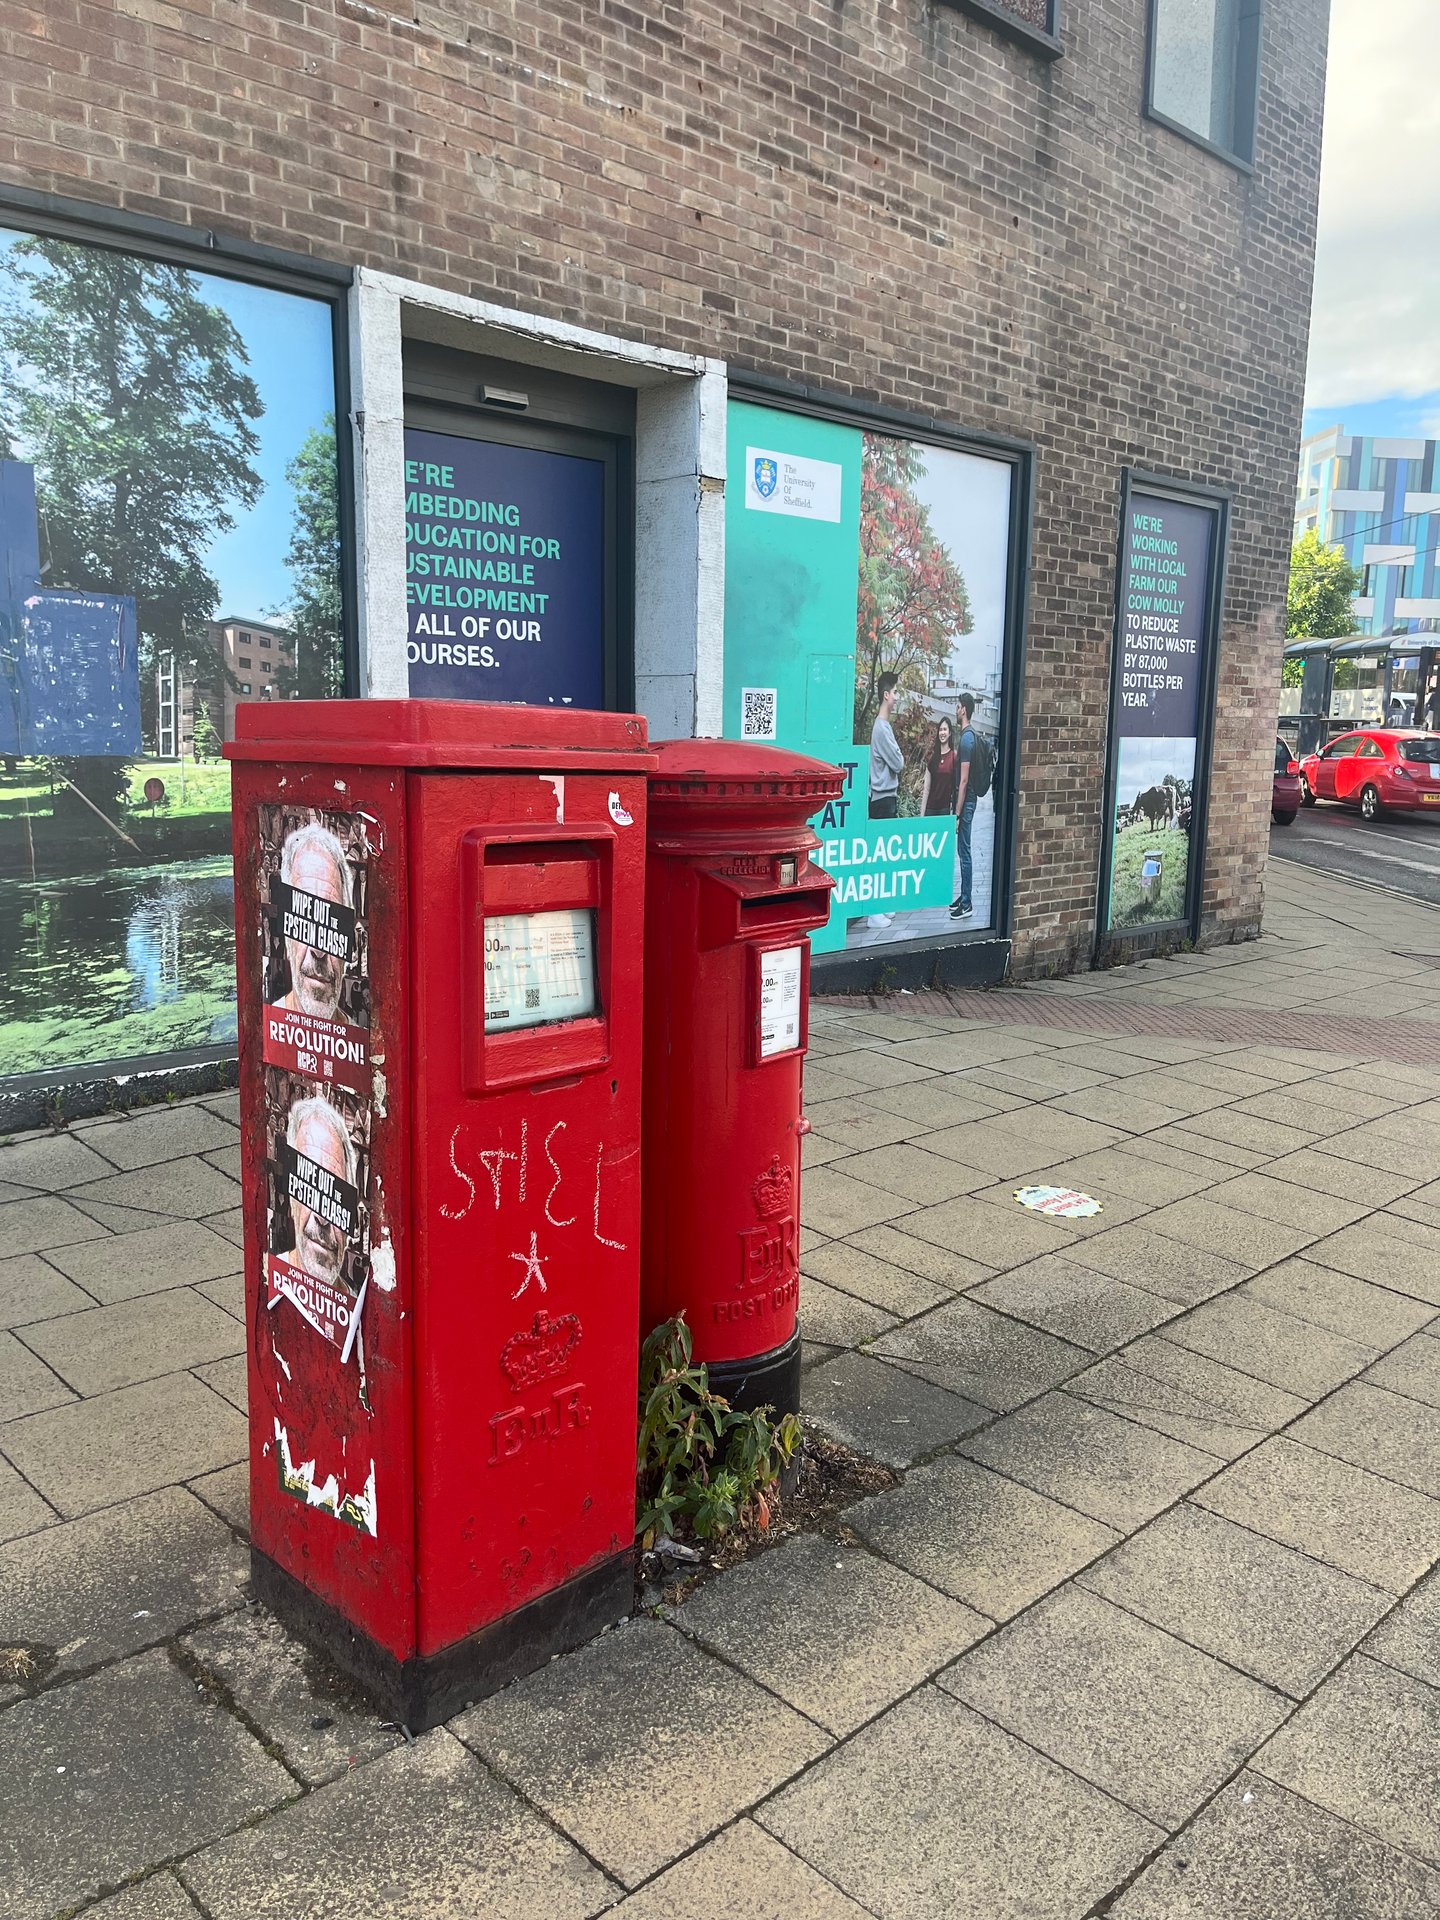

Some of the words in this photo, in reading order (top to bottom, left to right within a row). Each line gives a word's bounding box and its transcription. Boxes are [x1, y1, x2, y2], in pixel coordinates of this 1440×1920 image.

[405, 460, 455, 488] E'RE
[784, 464, 797, 474] The
[784, 475, 816, 490] University
[405, 491, 520, 526] MBEDDING
[1133, 513, 1163, 534] WE'RE
[405, 522, 515, 555] DUCATION
[519, 535, 561, 560] FOR
[1131, 534, 1178, 555] WORKING
[1130, 554, 1156, 572] WITH
[1158, 559, 1187, 577] LOCAL
[1129, 574, 1156, 592] FARM
[1157, 578, 1178, 595] OUR
[406, 582, 549, 614] EVELOPMENT
[1127, 594, 1153, 611] COW
[1154, 598, 1185, 615] MOLLY
[415, 613, 457, 637] ALL
[461, 616, 491, 638] OF
[495, 618, 541, 641] OUR
[1126, 614, 1140, 630] TO
[1142, 616, 1179, 633] REDUCE
[406, 642, 500, 667] OURSES.
[1125, 634, 1164, 651] PLASTIC
[1165, 637, 1197, 654] WASTE
[1124, 653, 1138, 668] BY
[1139, 655, 1168, 671] 87,000
[1123, 673, 1165, 689] BOTTLES
[1166, 675, 1183, 690] PER
[1122, 692, 1149, 707] YEAR.
[821, 801, 850, 829] AT
[831, 869, 926, 904] NABILITY
[292, 889, 312, 920] WIPE
[313, 898, 331, 926] OUT
[283, 911, 316, 946] EPSTEIN
[317, 926, 348, 959] CLASS!
[285, 1012, 300, 1025] JOIN
[301, 1015, 312, 1028] THE
[313, 1019, 332, 1033] FIGHT
[333, 1024, 347, 1036] FOR
[269, 1020, 365, 1065] REVOLUTION!
[296, 1154, 318, 1187] WIPE
[318, 1168, 335, 1198] OUT
[334, 1189, 342, 1203] THE
[288, 1172, 320, 1213] EPSTEIN
[321, 1194, 351, 1233] CLASS!
[288, 1267, 303, 1282] JOIN
[303, 1273, 315, 1288] THE
[315, 1281, 333, 1298] FIGHT
[334, 1290, 348, 1305] FOR
